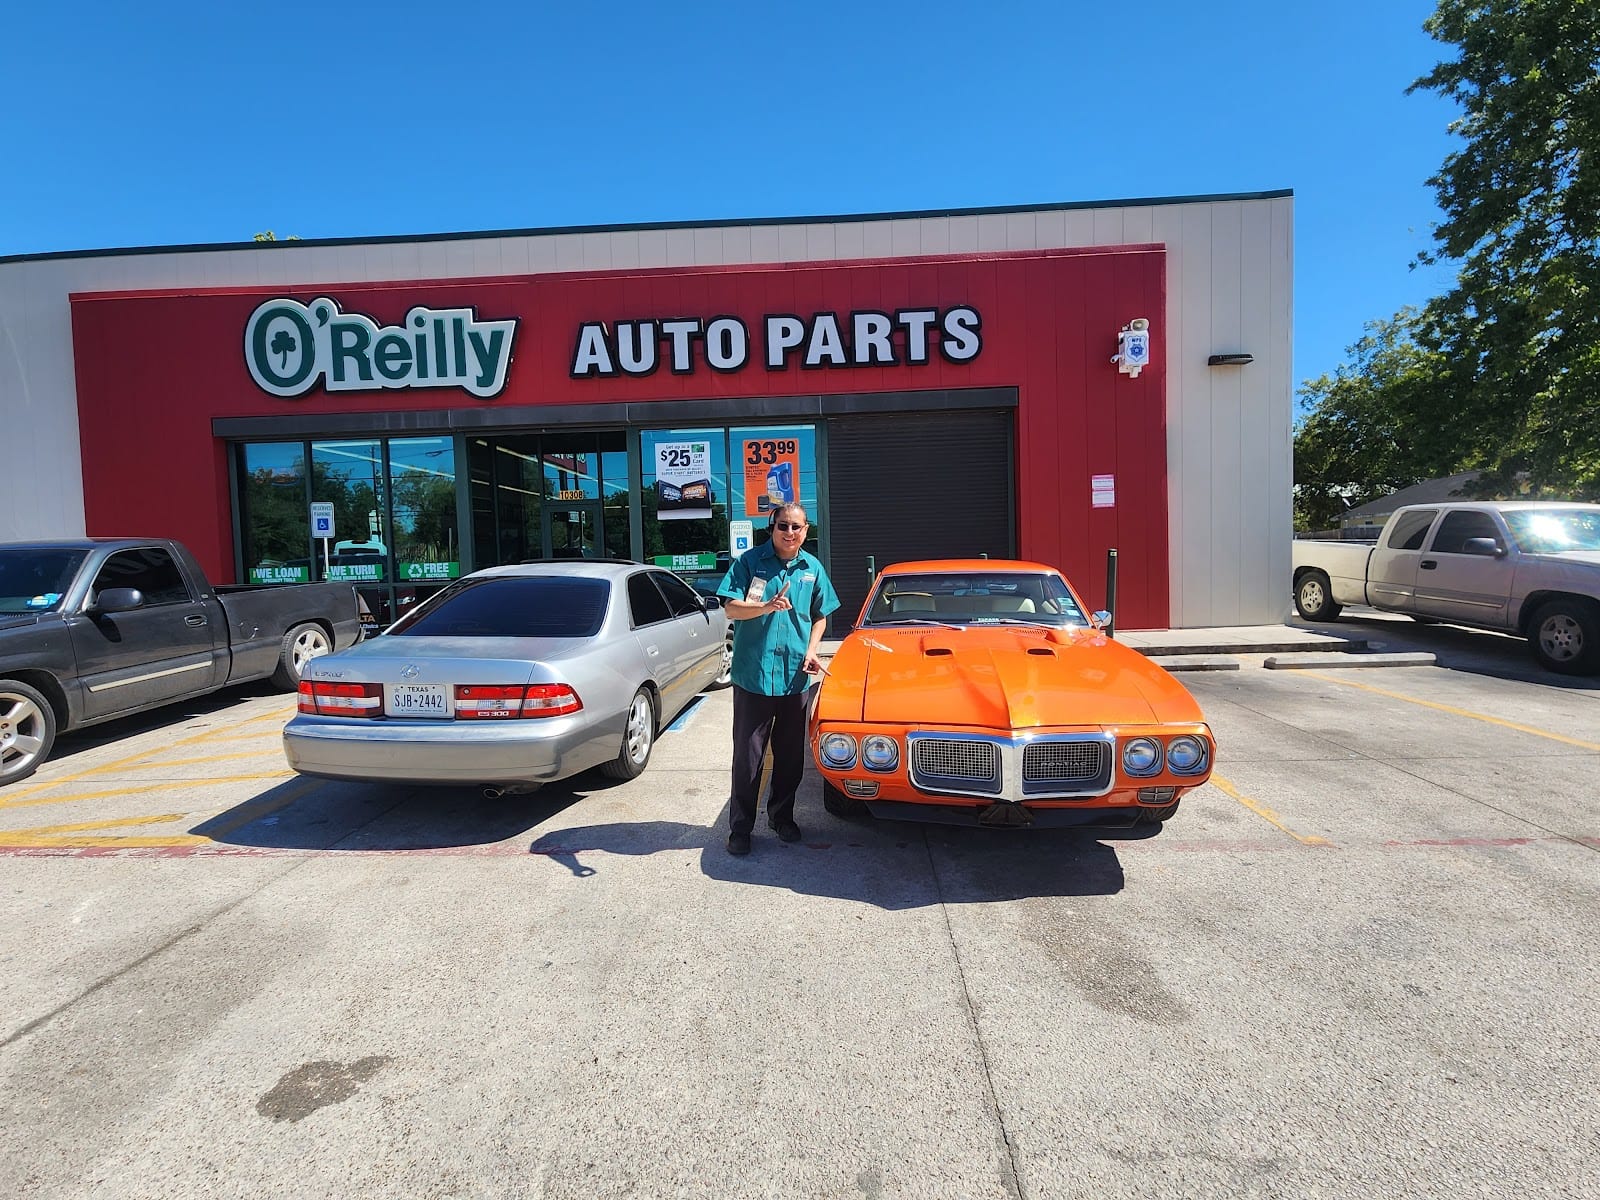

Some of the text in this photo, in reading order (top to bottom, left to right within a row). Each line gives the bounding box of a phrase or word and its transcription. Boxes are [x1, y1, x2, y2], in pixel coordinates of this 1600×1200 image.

[252, 305, 505, 389] O'Reilly
[573, 309, 980, 375] AUTO PARTS
[660, 449, 691, 467] $25
[560, 490, 583, 500] 10308
[672, 554, 699, 566] FREE
[256, 567, 301, 578] WE LOAN
[330, 564, 375, 576] WE TURN
[423, 562, 449, 574] FREE
